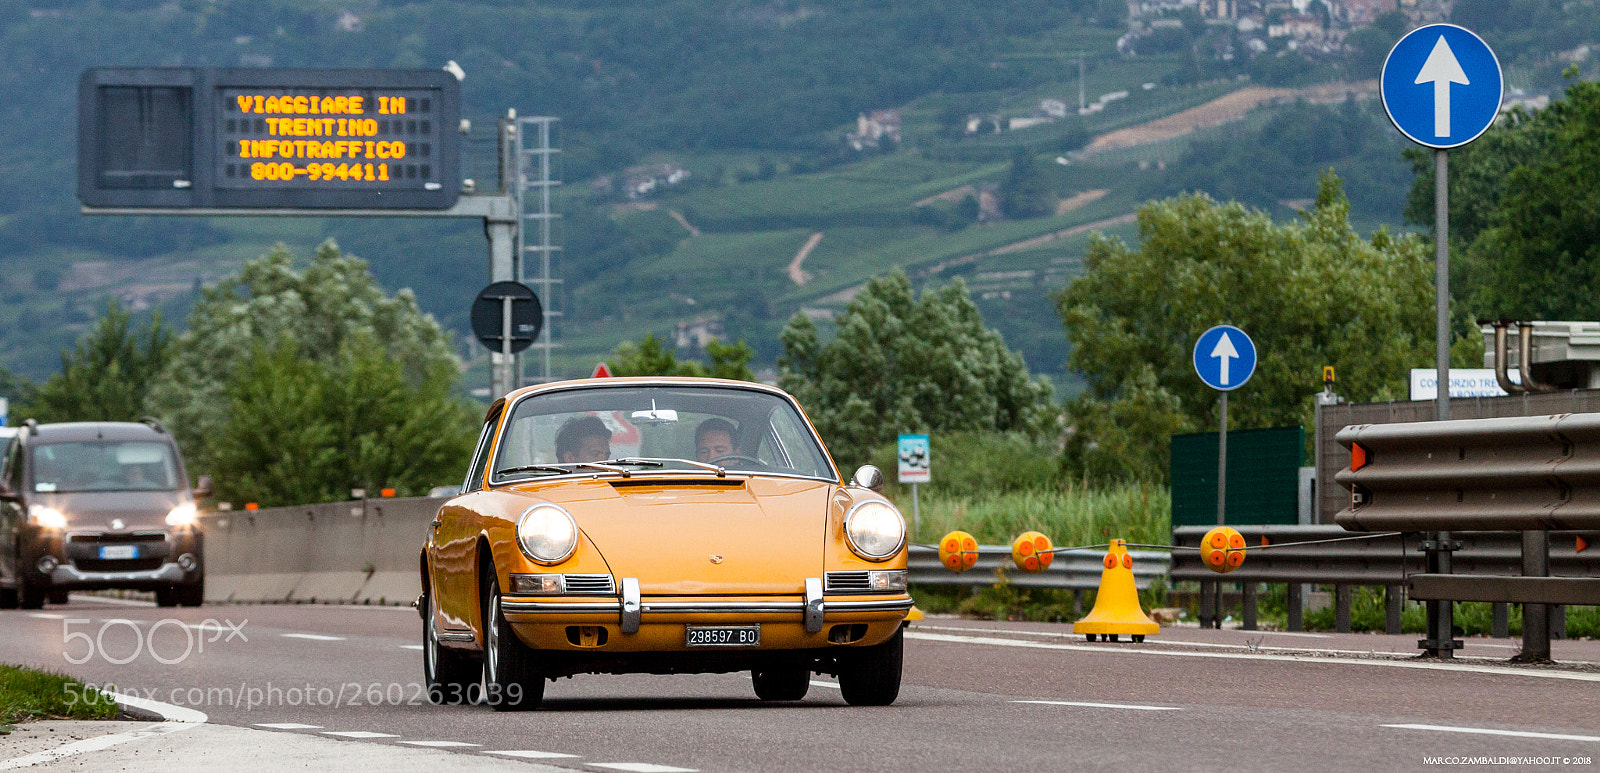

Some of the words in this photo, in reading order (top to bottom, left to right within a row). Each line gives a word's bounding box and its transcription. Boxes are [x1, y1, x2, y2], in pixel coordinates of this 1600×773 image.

[378, 96, 406, 114] IN
[265, 118, 378, 136] TRENTINO
[239, 139, 406, 158] INFOTRAFFICO
[251, 162, 389, 180] 800-994411
[690, 630, 733, 643] 298597
